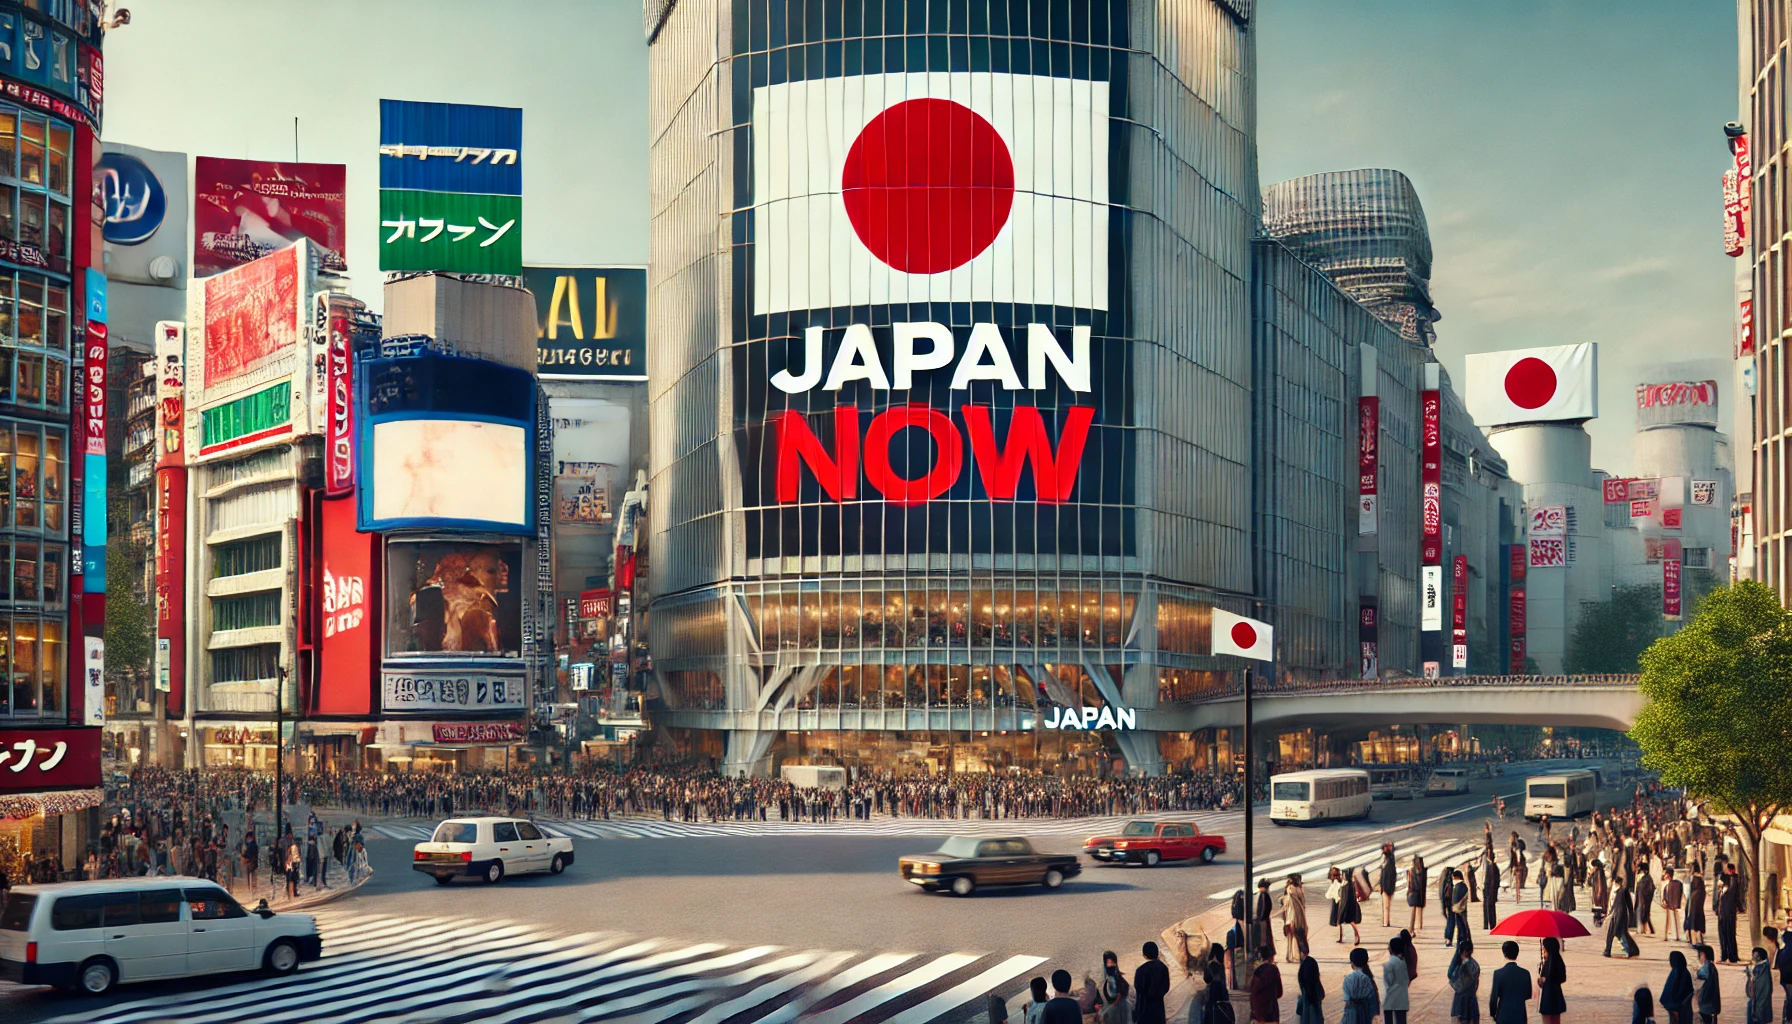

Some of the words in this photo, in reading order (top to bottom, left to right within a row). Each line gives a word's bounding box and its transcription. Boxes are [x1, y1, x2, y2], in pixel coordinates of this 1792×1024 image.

[770, 321, 1092, 394] JAPAN
[775, 402, 1096, 507] NOW
[1044, 706, 1136, 730] JAPAN
